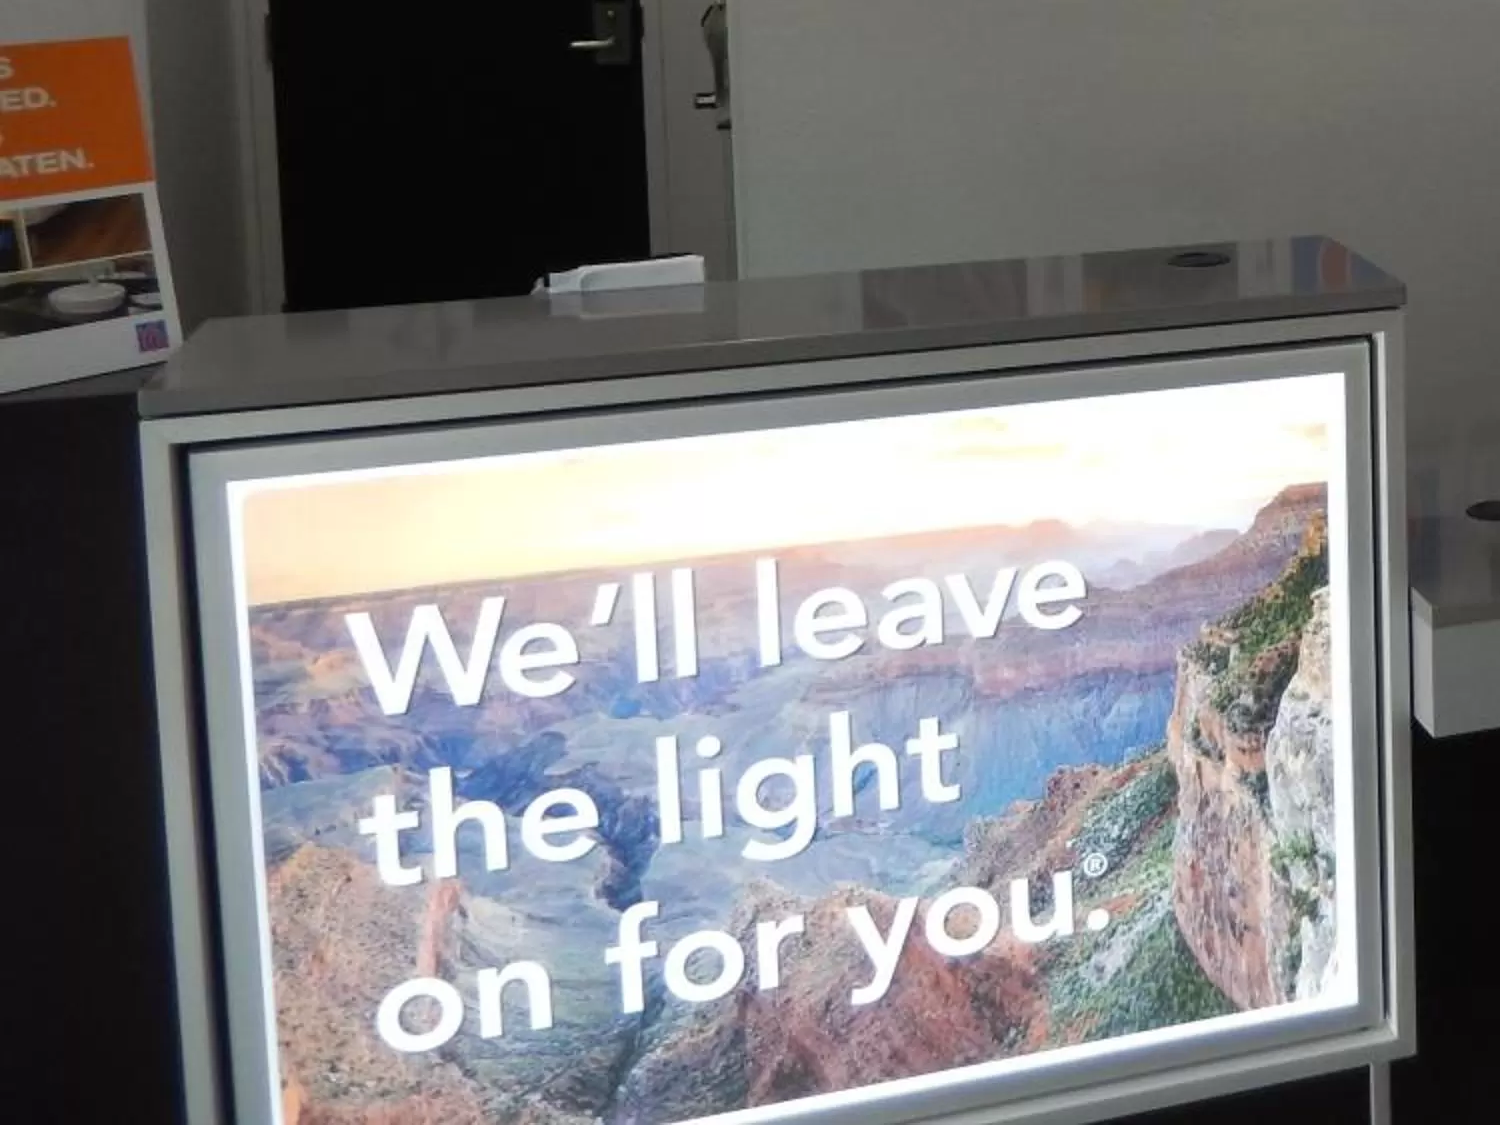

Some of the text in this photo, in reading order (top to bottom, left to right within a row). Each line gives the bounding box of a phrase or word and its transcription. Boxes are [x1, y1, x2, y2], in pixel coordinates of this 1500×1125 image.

[0, 146, 96, 179] ATEN.
[344, 557, 1087, 717] We'll leave
[358, 710, 962, 887] the light
[375, 957, 554, 1054] on
[603, 900, 806, 1016] for
